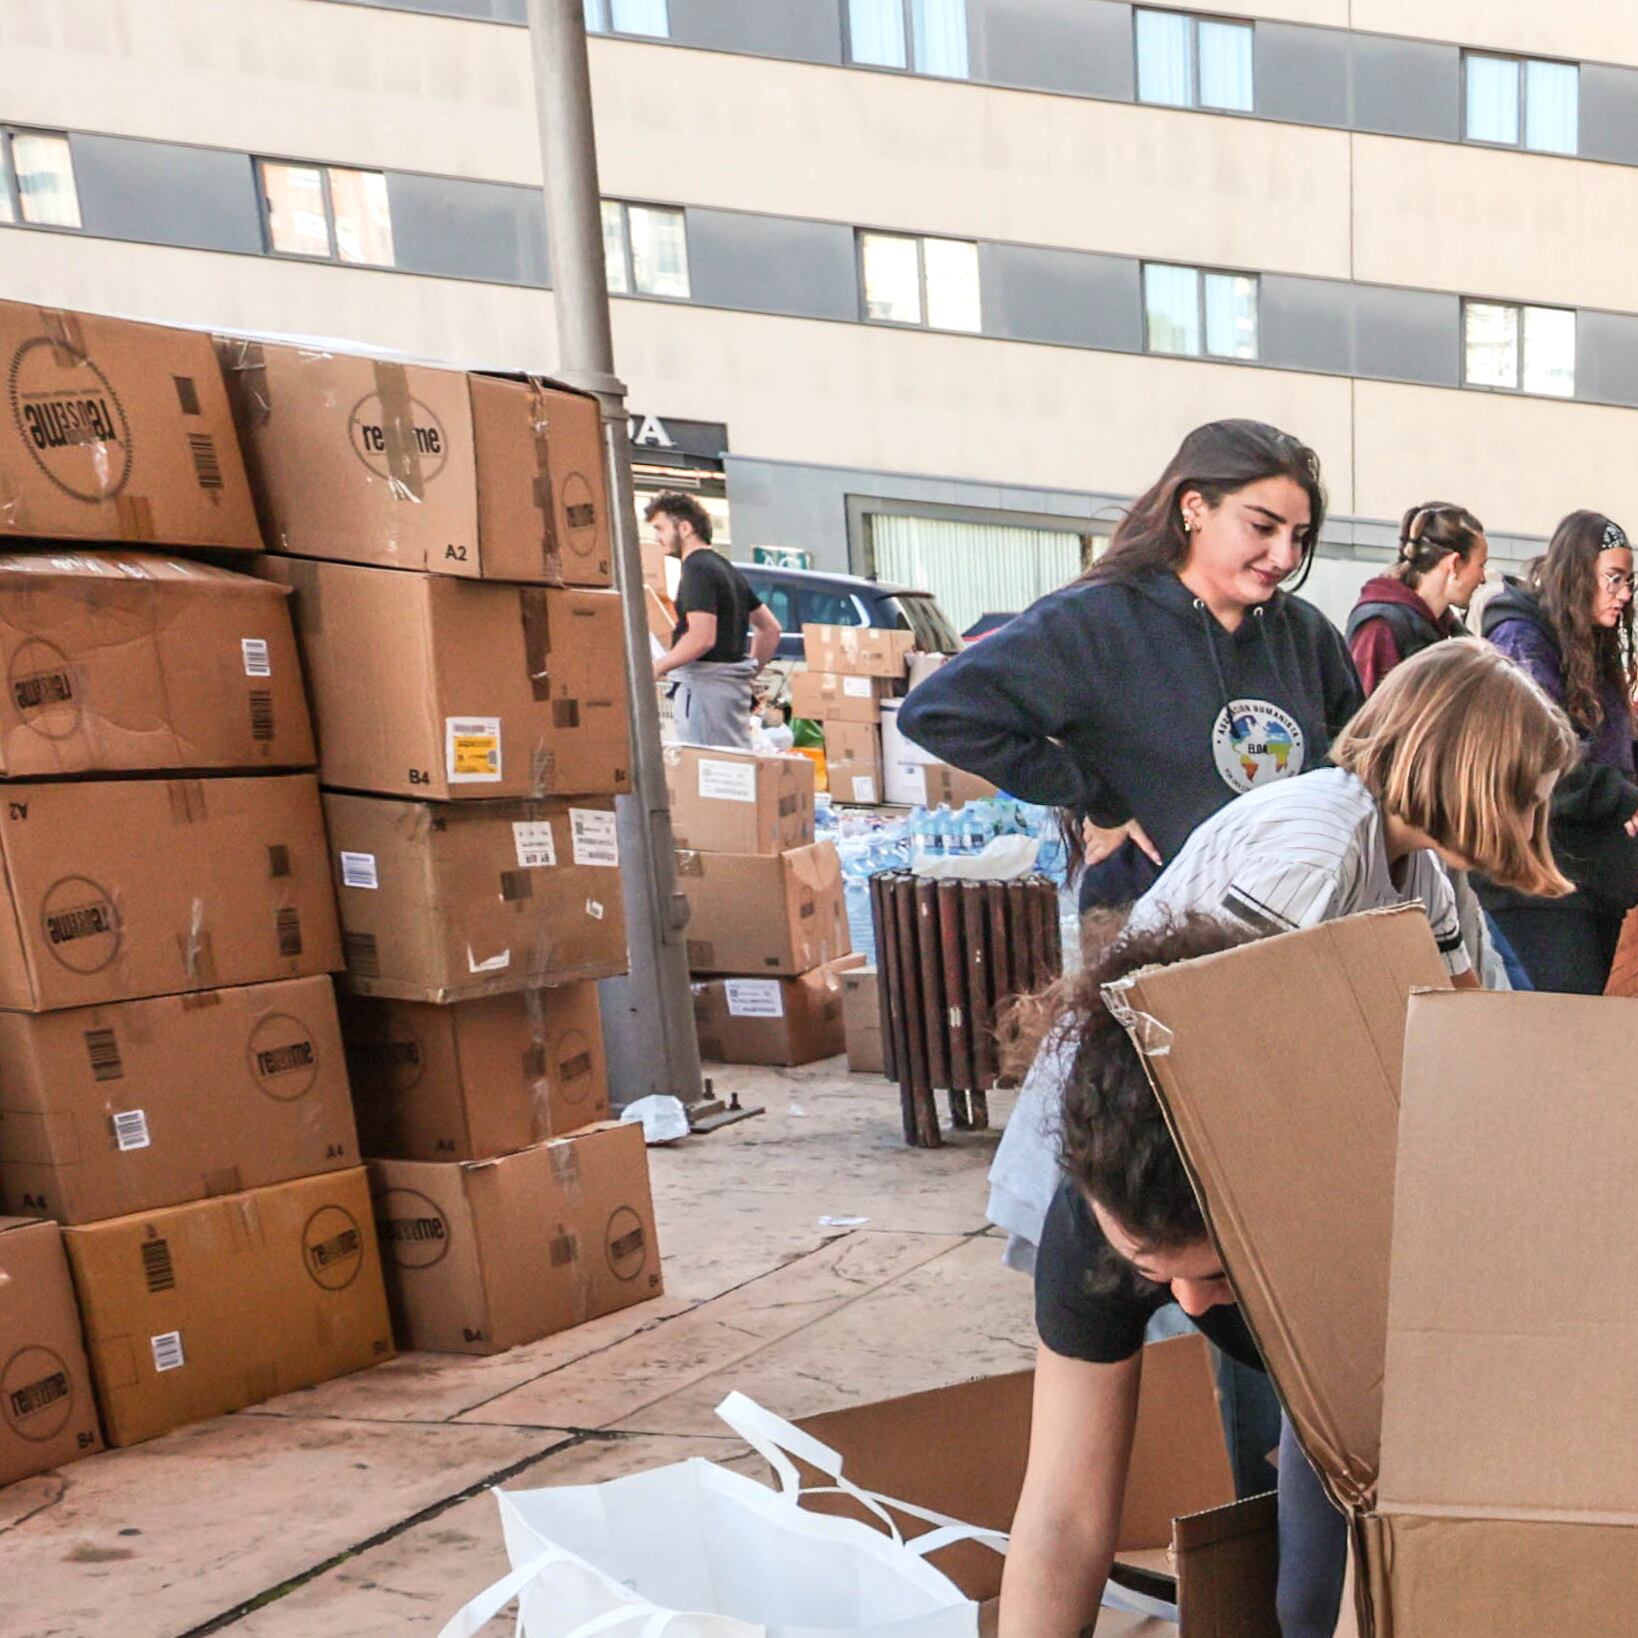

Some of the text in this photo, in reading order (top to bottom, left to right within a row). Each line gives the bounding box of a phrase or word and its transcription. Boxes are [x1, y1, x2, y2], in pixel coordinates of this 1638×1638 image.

[445, 543, 467, 562] A2
[408, 768, 431, 786] B4
[325, 1145, 346, 1161] A4
